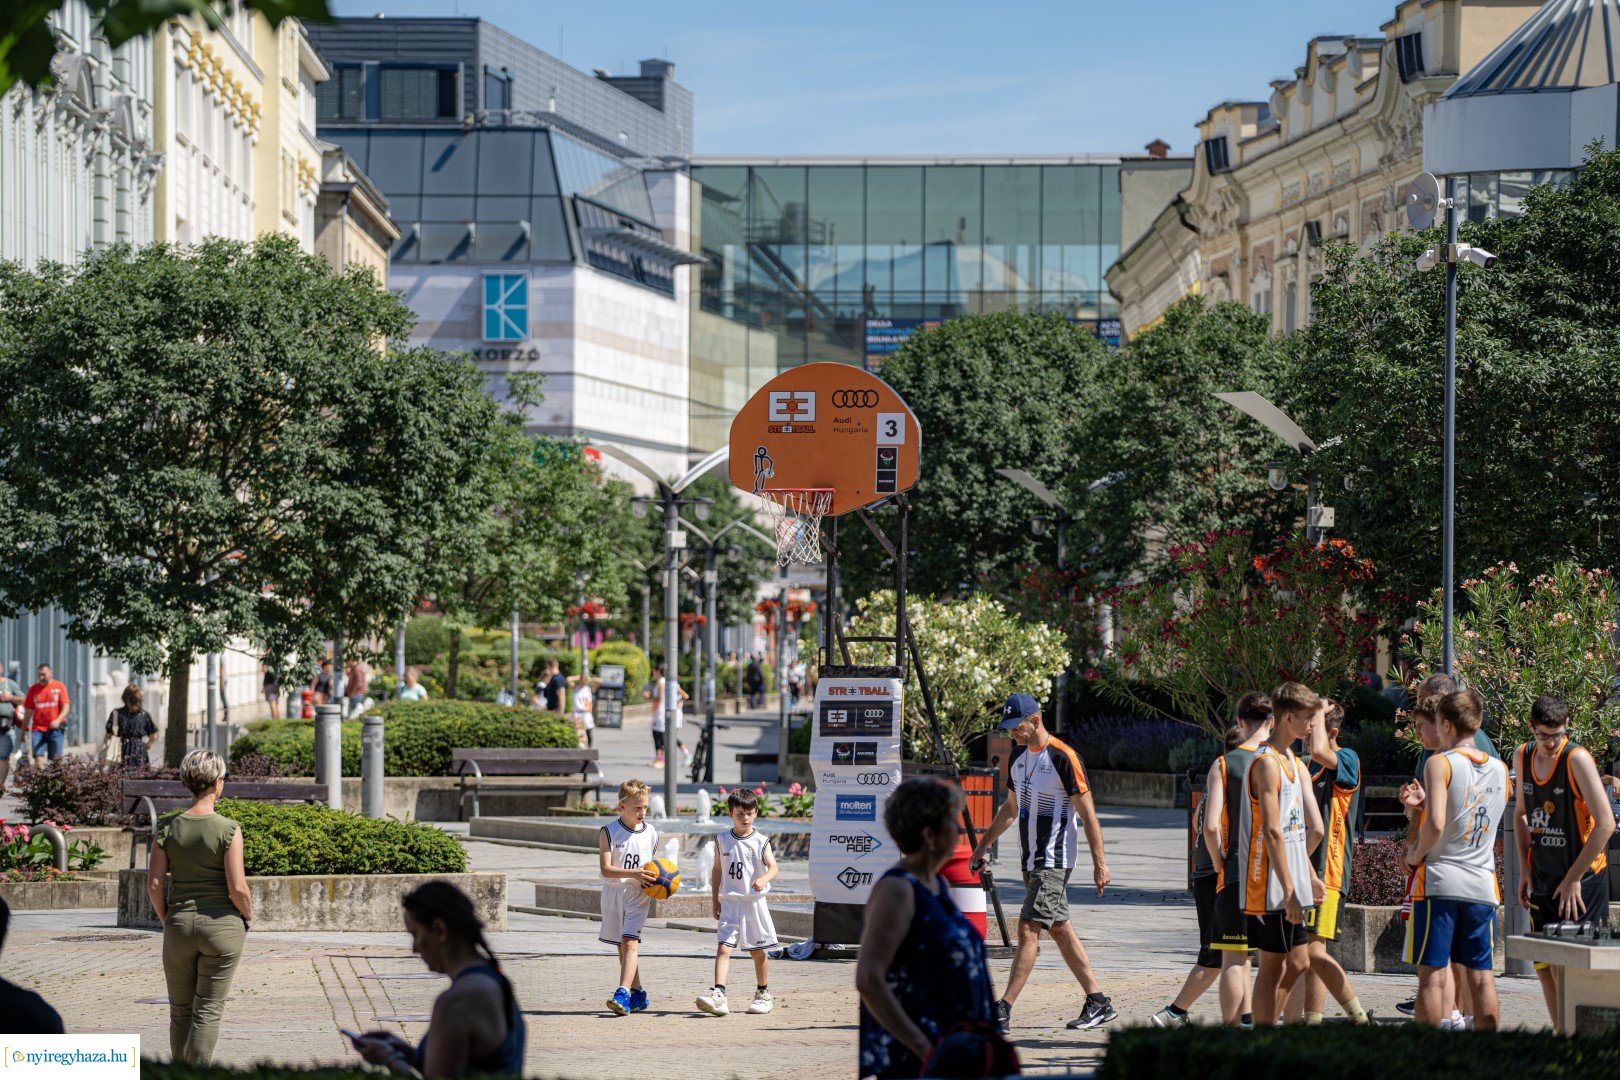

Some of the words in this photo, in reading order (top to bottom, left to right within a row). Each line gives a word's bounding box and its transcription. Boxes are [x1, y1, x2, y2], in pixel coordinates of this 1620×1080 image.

[833, 426, 868, 434] Hungaria
[885, 420, 897, 437] 3
[841, 801, 871, 809] molten
[829, 836, 872, 844] POWER
[624, 853, 640, 869] 68
[729, 862, 743, 880] 48
[845, 872, 873, 885] TOTI
